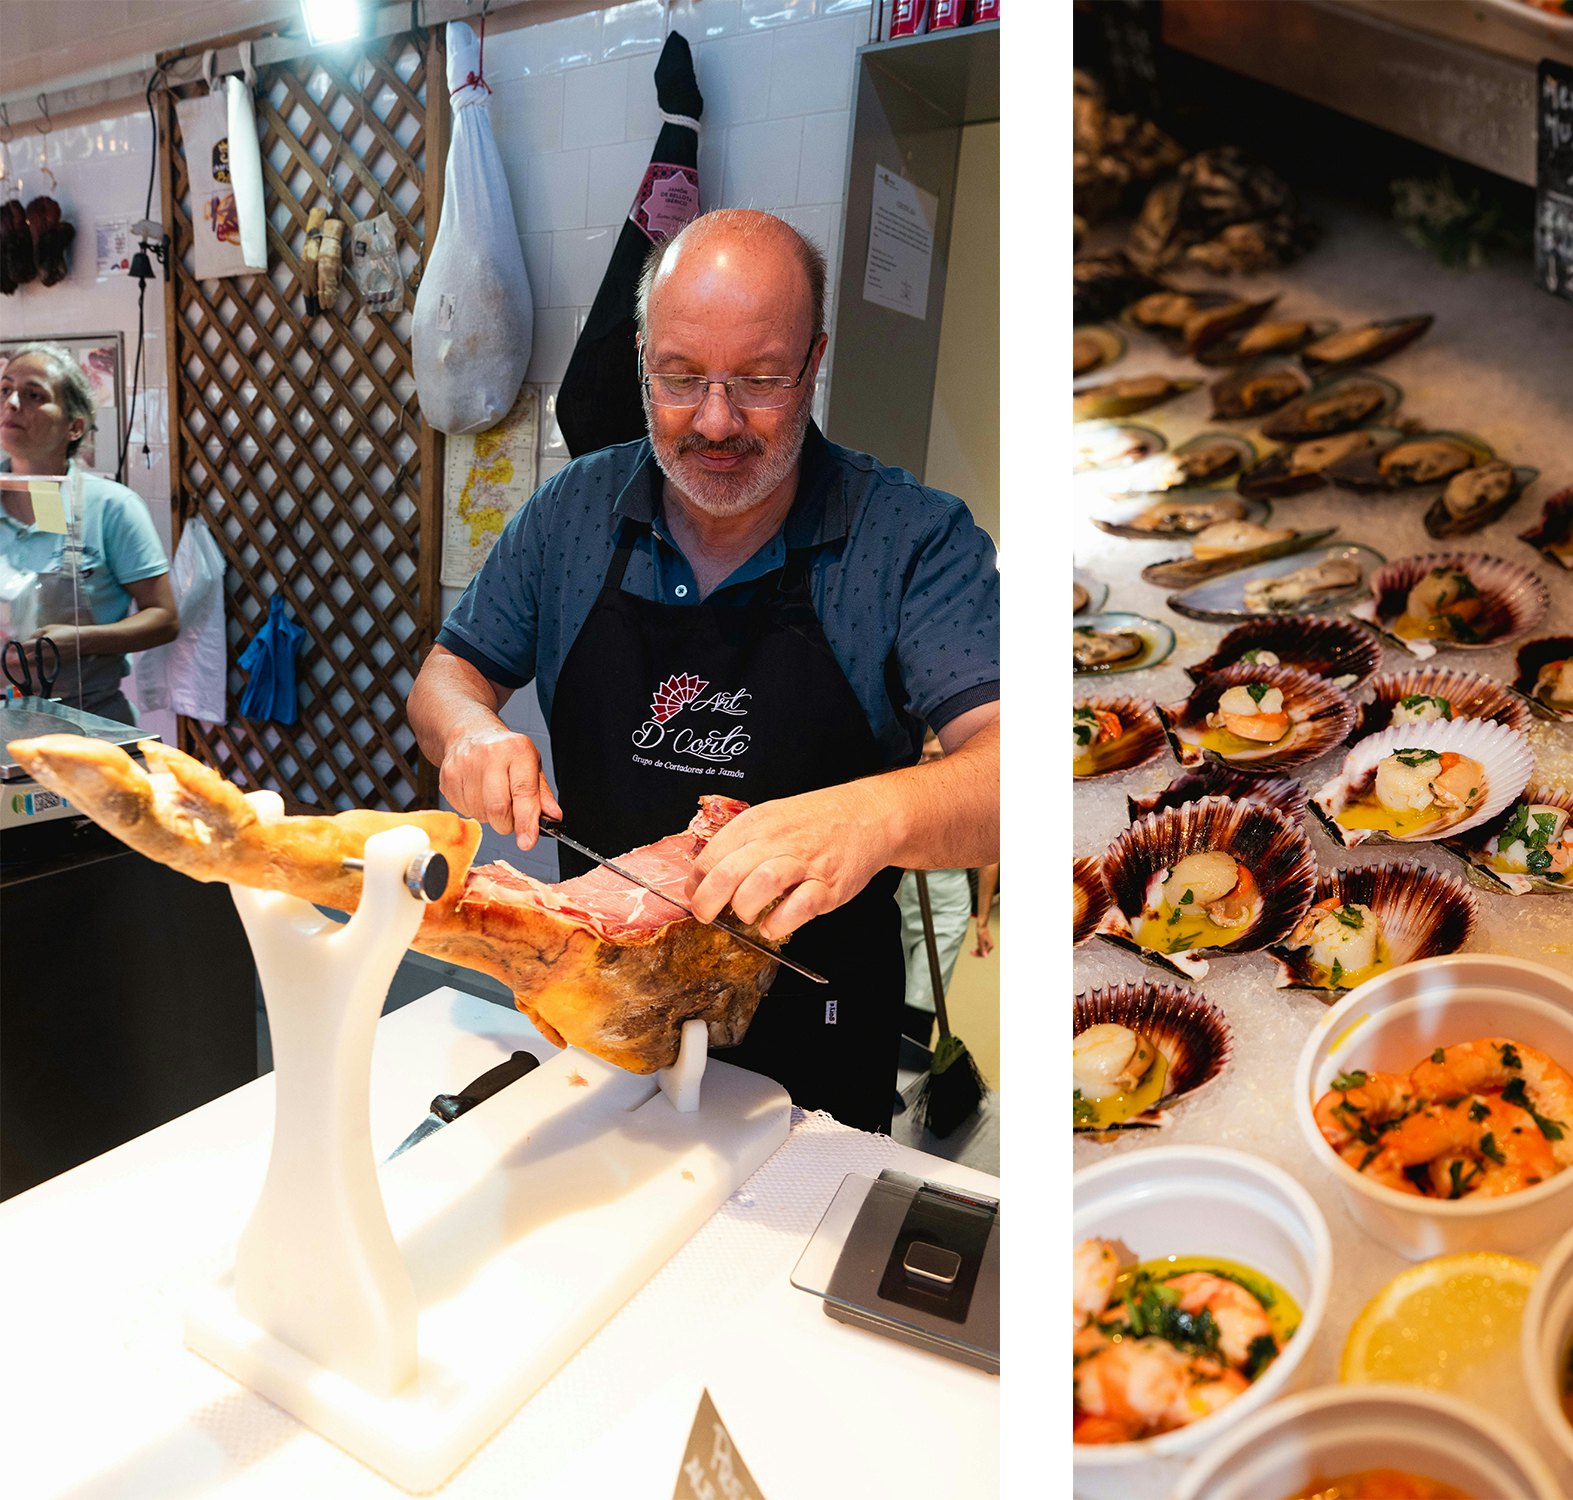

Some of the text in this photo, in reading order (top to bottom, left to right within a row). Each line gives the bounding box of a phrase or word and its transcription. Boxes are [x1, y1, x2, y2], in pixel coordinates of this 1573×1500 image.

[632, 754, 654, 766] Grupo
[654, 760, 664, 768] de
[664, 761, 705, 775] Cortadores
[705, 767, 716, 775] de
